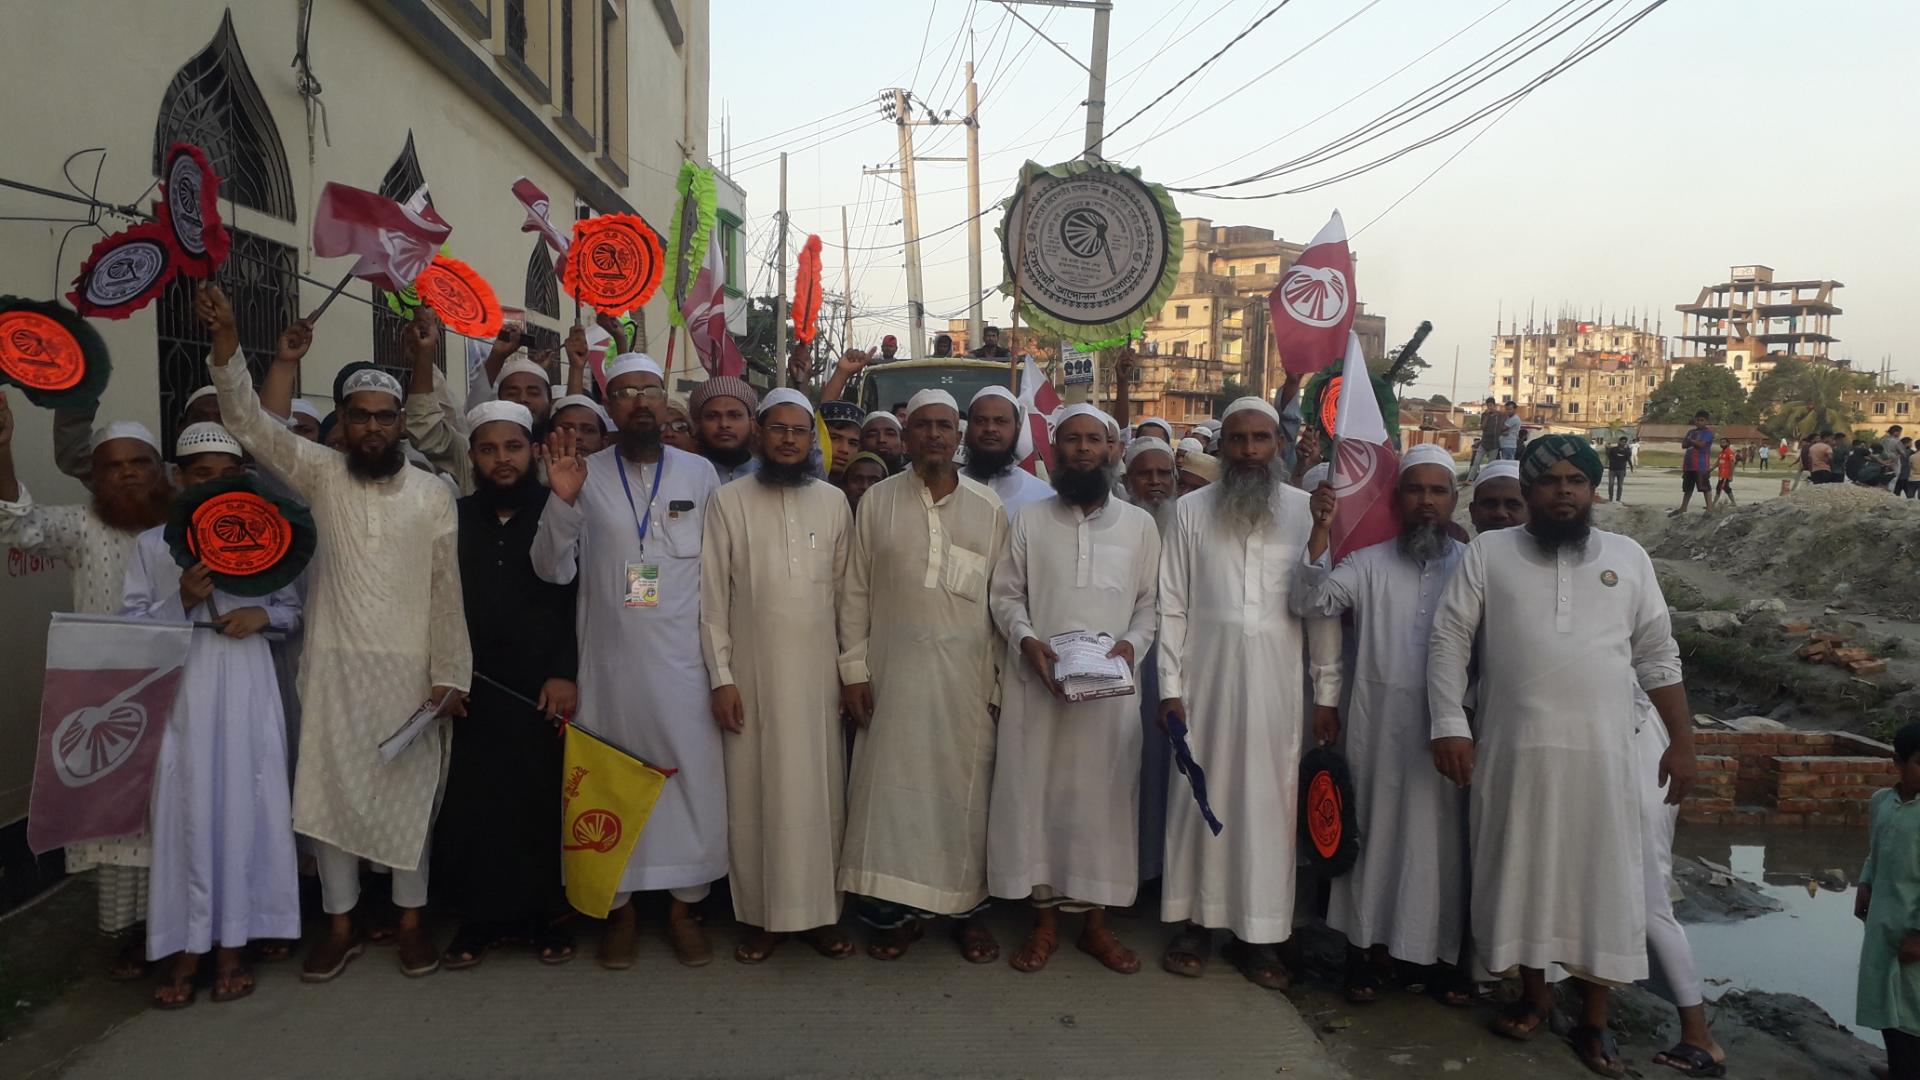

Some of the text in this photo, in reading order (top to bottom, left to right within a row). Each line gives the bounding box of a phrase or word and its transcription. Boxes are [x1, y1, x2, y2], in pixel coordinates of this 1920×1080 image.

[1028, 247, 1056, 288] ইসলামী
[1054, 283, 1097, 301] আন্দোলন
[1102, 265, 1139, 299] বাংলাদেশ
